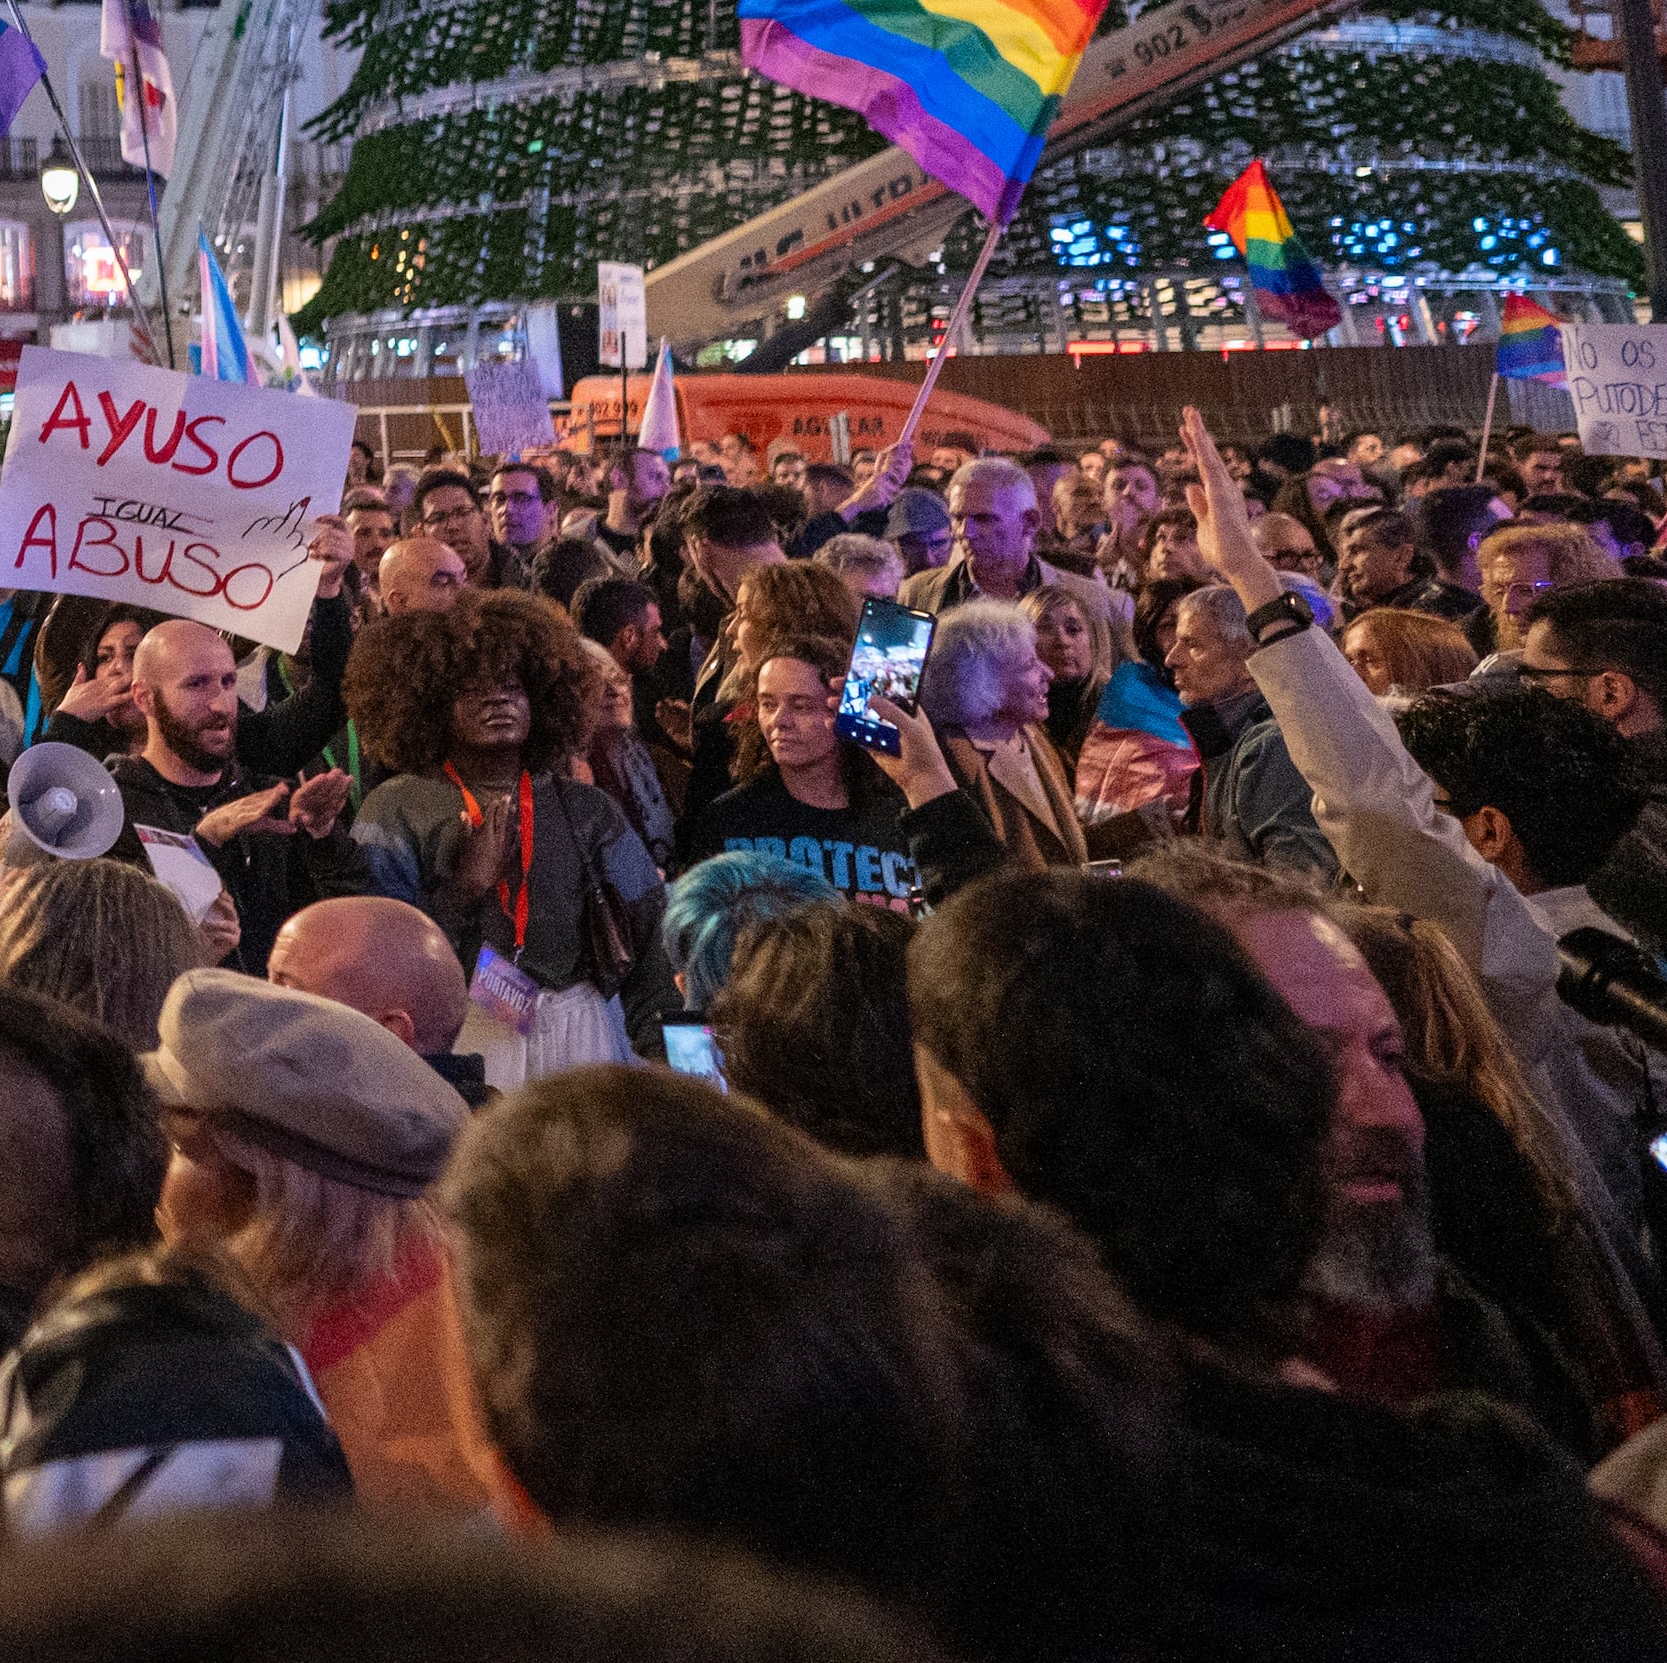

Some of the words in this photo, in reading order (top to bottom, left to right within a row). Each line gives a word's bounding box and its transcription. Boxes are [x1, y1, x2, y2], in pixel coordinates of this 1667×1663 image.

[1621, 339, 1656, 370] OS
[38, 381, 285, 489] AYUSO
[88, 496, 194, 534] IGUAL
[14, 503, 274, 611] ABUSO
